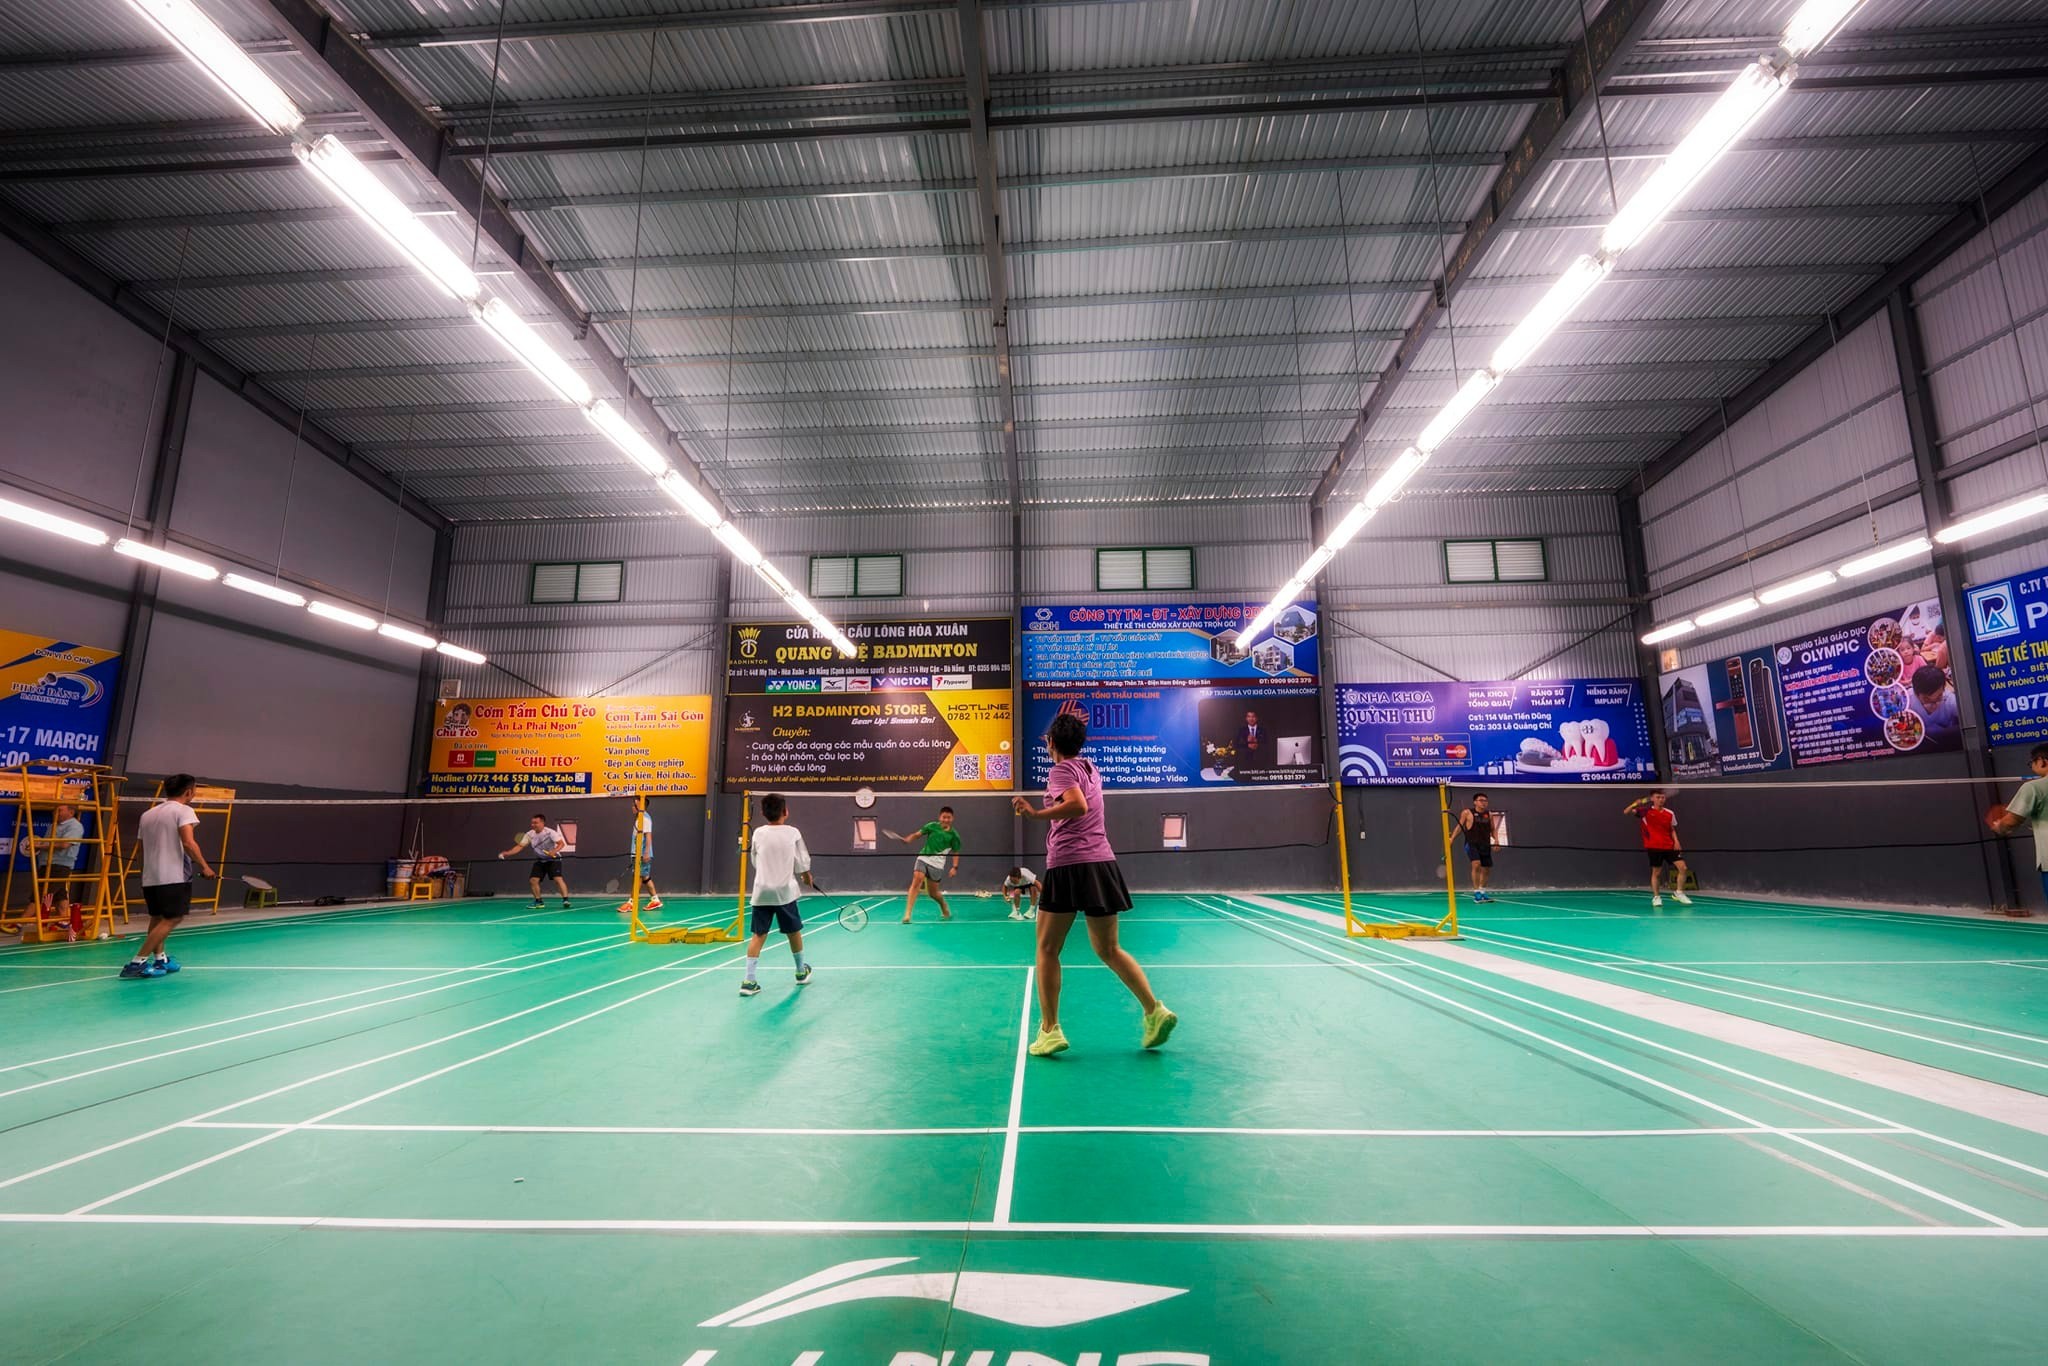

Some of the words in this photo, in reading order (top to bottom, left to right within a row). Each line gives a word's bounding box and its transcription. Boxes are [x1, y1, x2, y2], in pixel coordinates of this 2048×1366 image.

[1069, 607, 1105, 622] CÔNG
[1105, 608, 1124, 621] TY
[1124, 608, 1143, 621] TM
[1178, 605, 1204, 620] XÂY
[1204, 604, 1241, 622] DỰNG
[1134, 621, 1146, 629] THI
[786, 625, 809, 640] CỬA
[874, 625, 905, 638] LÔNG
[935, 622, 968, 636] XUÂN
[1831, 630, 1849, 644] GIÁO
[775, 645, 833, 664] QUANG
[872, 643, 978, 659] BADMINTON
[1801, 639, 1860, 665] OLYMPIC
[1980, 644, 2011, 668] THIẾT
[2012, 639, 2030, 662] KẾ
[786, 680, 817, 690] YONEX
[888, 676, 929, 686] VICTOR
[1359, 691, 1390, 704] NHA
[1392, 690, 1434, 703] KHOA
[1594, 697, 1623, 705] IMPLANT
[474, 704, 504, 719] Cơm
[507, 702, 537, 718] Tấm
[541, 704, 568, 718] Chú
[572, 703, 597, 718] Tèo
[772, 705, 793, 718] H2
[795, 704, 881, 717] BADMINTON
[884, 703, 927, 716] STORE
[947, 703, 1010, 711] HOTLINE
[947, 712, 971, 721] 0782
[974, 712, 990, 720] 112
[993, 711, 1011, 720] 442
[1092, 703, 1130, 729] BITI
[1401, 705, 1436, 723] THƯ
[851, 718, 873, 726] Gear
[890, 717, 919, 725] Smash
[772, 726, 811, 739] Chuyên:
[34, 728, 100, 752] MARCH
[751, 741, 775, 752] Cung
[776, 740, 794, 751] cấp
[795, 741, 808, 750] đa
[809, 740, 832, 751] dạng
[833, 740, 852, 749] các
[899, 739, 911, 748] áo
[931, 739, 951, 749] lông
[1122, 745, 1133, 753] kế
[1143, 744, 1167, 754] thống
[1392, 747, 1413, 756] ATM
[1420, 747, 1440, 756] VISA
[751, 753, 759, 761] In
[760, 752, 773, 761] áo
[774, 752, 788, 762] hội
[789, 752, 817, 762] nhóm,
[818, 752, 837, 761] câu
[837, 752, 852, 762] lạc
[853, 752, 865, 762] bộ
[1103, 755, 1114, 764] Hệ
[1114, 755, 1138, 764] thống
[750, 763, 767, 774] Phụ
[767, 763, 787, 773] kiện
[807, 763, 827, 773] lông
[1135, 764, 1161, 773] Quảng
[1161, 764, 1177, 773] Cáo
[431, 774, 465, 783] Hotline:
[466, 774, 489, 783] 0772
[491, 774, 510, 782] 446
[511, 774, 529, 782] 558
[532, 773, 553, 784] hoặc
[554, 774, 574, 783] Zalo
[1116, 775, 1143, 784] Google
[1143, 775, 1161, 784] Map
[1386, 776, 1408, 784] KHOA
[512, 783, 527, 793] 61
